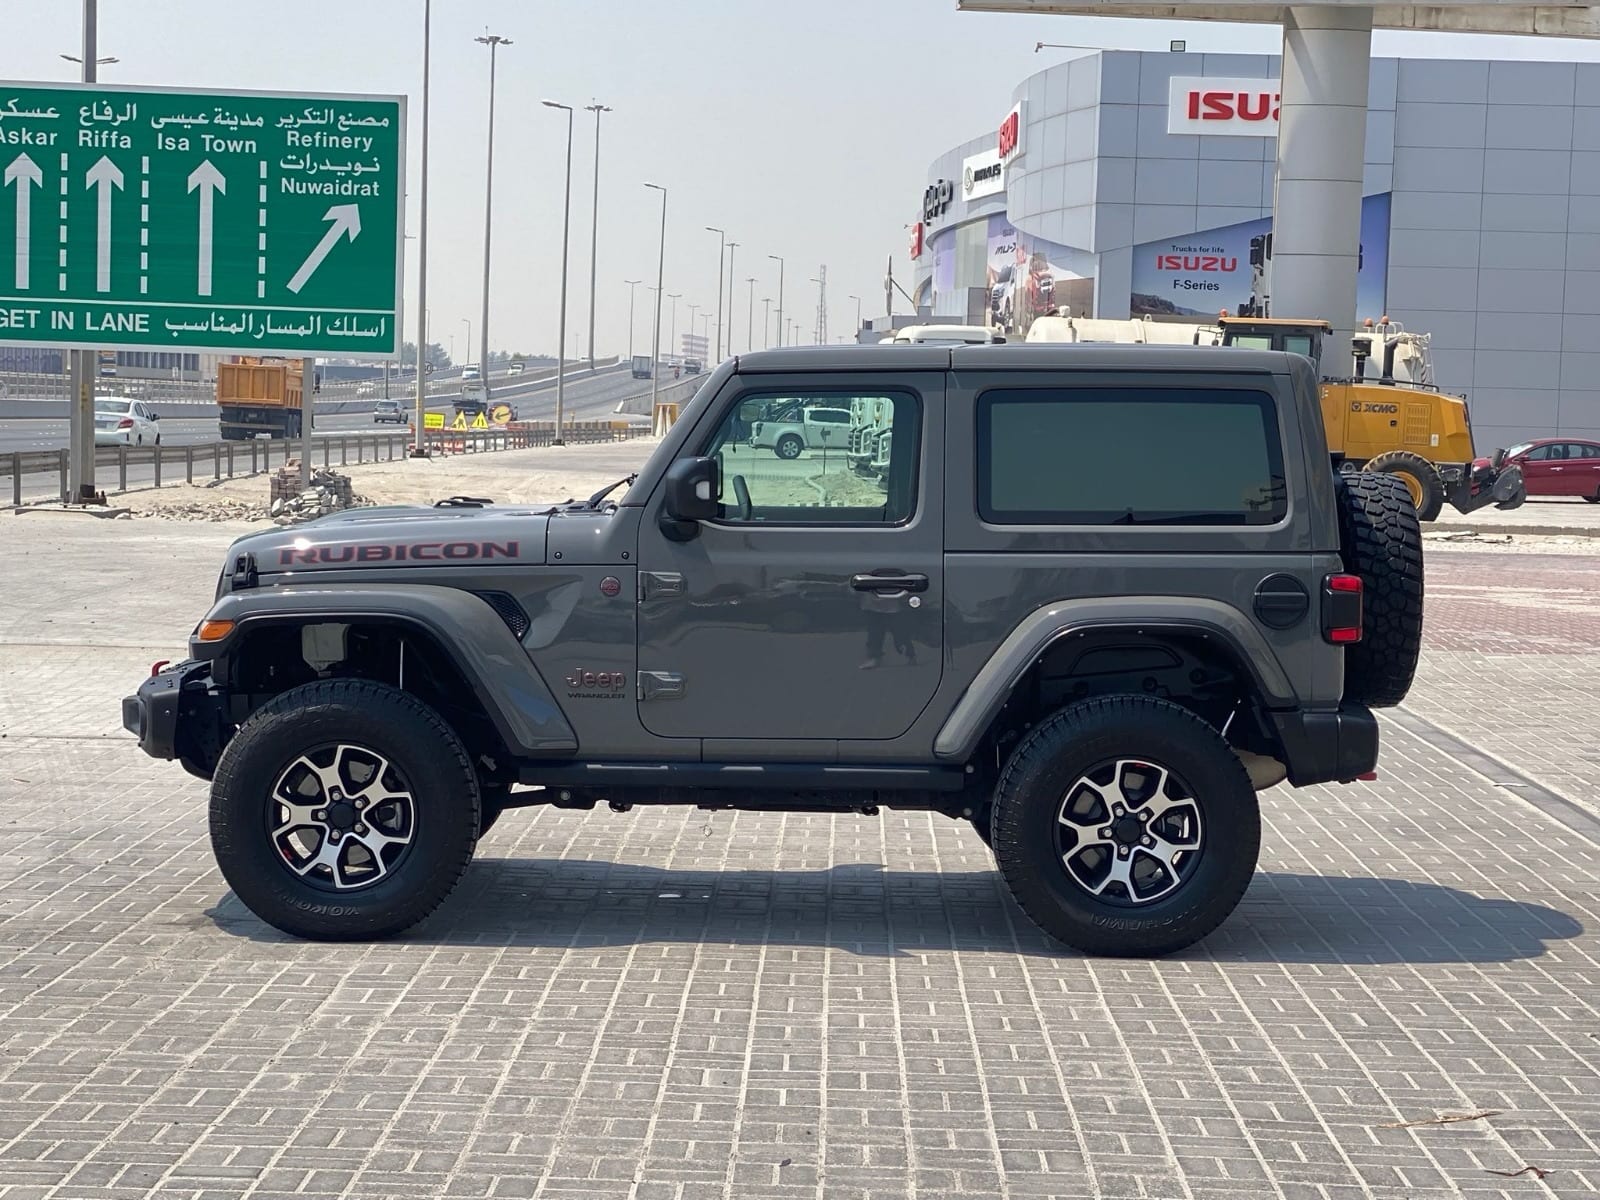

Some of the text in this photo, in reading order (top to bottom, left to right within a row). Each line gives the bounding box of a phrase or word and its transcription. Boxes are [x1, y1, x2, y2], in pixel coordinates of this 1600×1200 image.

[79, 100, 137, 126] الرفاع
[1188, 91, 1279, 121] ISU
[151, 107, 264, 131] مدينة عيسى
[275, 107, 389, 131] مصنع التكرير
[78, 129, 131, 148] Riffa
[158, 133, 257, 153] Isa Town
[287, 130, 373, 152] Refinery
[280, 152, 380, 176] نويدرات
[281, 177, 380, 196] Nuwaidrat
[1172, 245, 1197, 253] Trucks
[1157, 255, 1238, 272] ISUZU
[1173, 279, 1220, 291] F-Series
[51, 310, 74, 330] IN
[86, 311, 150, 332] LANE
[326, 317, 385, 337] اسلك
[1364, 403, 1398, 414] XCMG
[279, 541, 519, 565] RUBICON
[566, 667, 626, 691] Jeep
